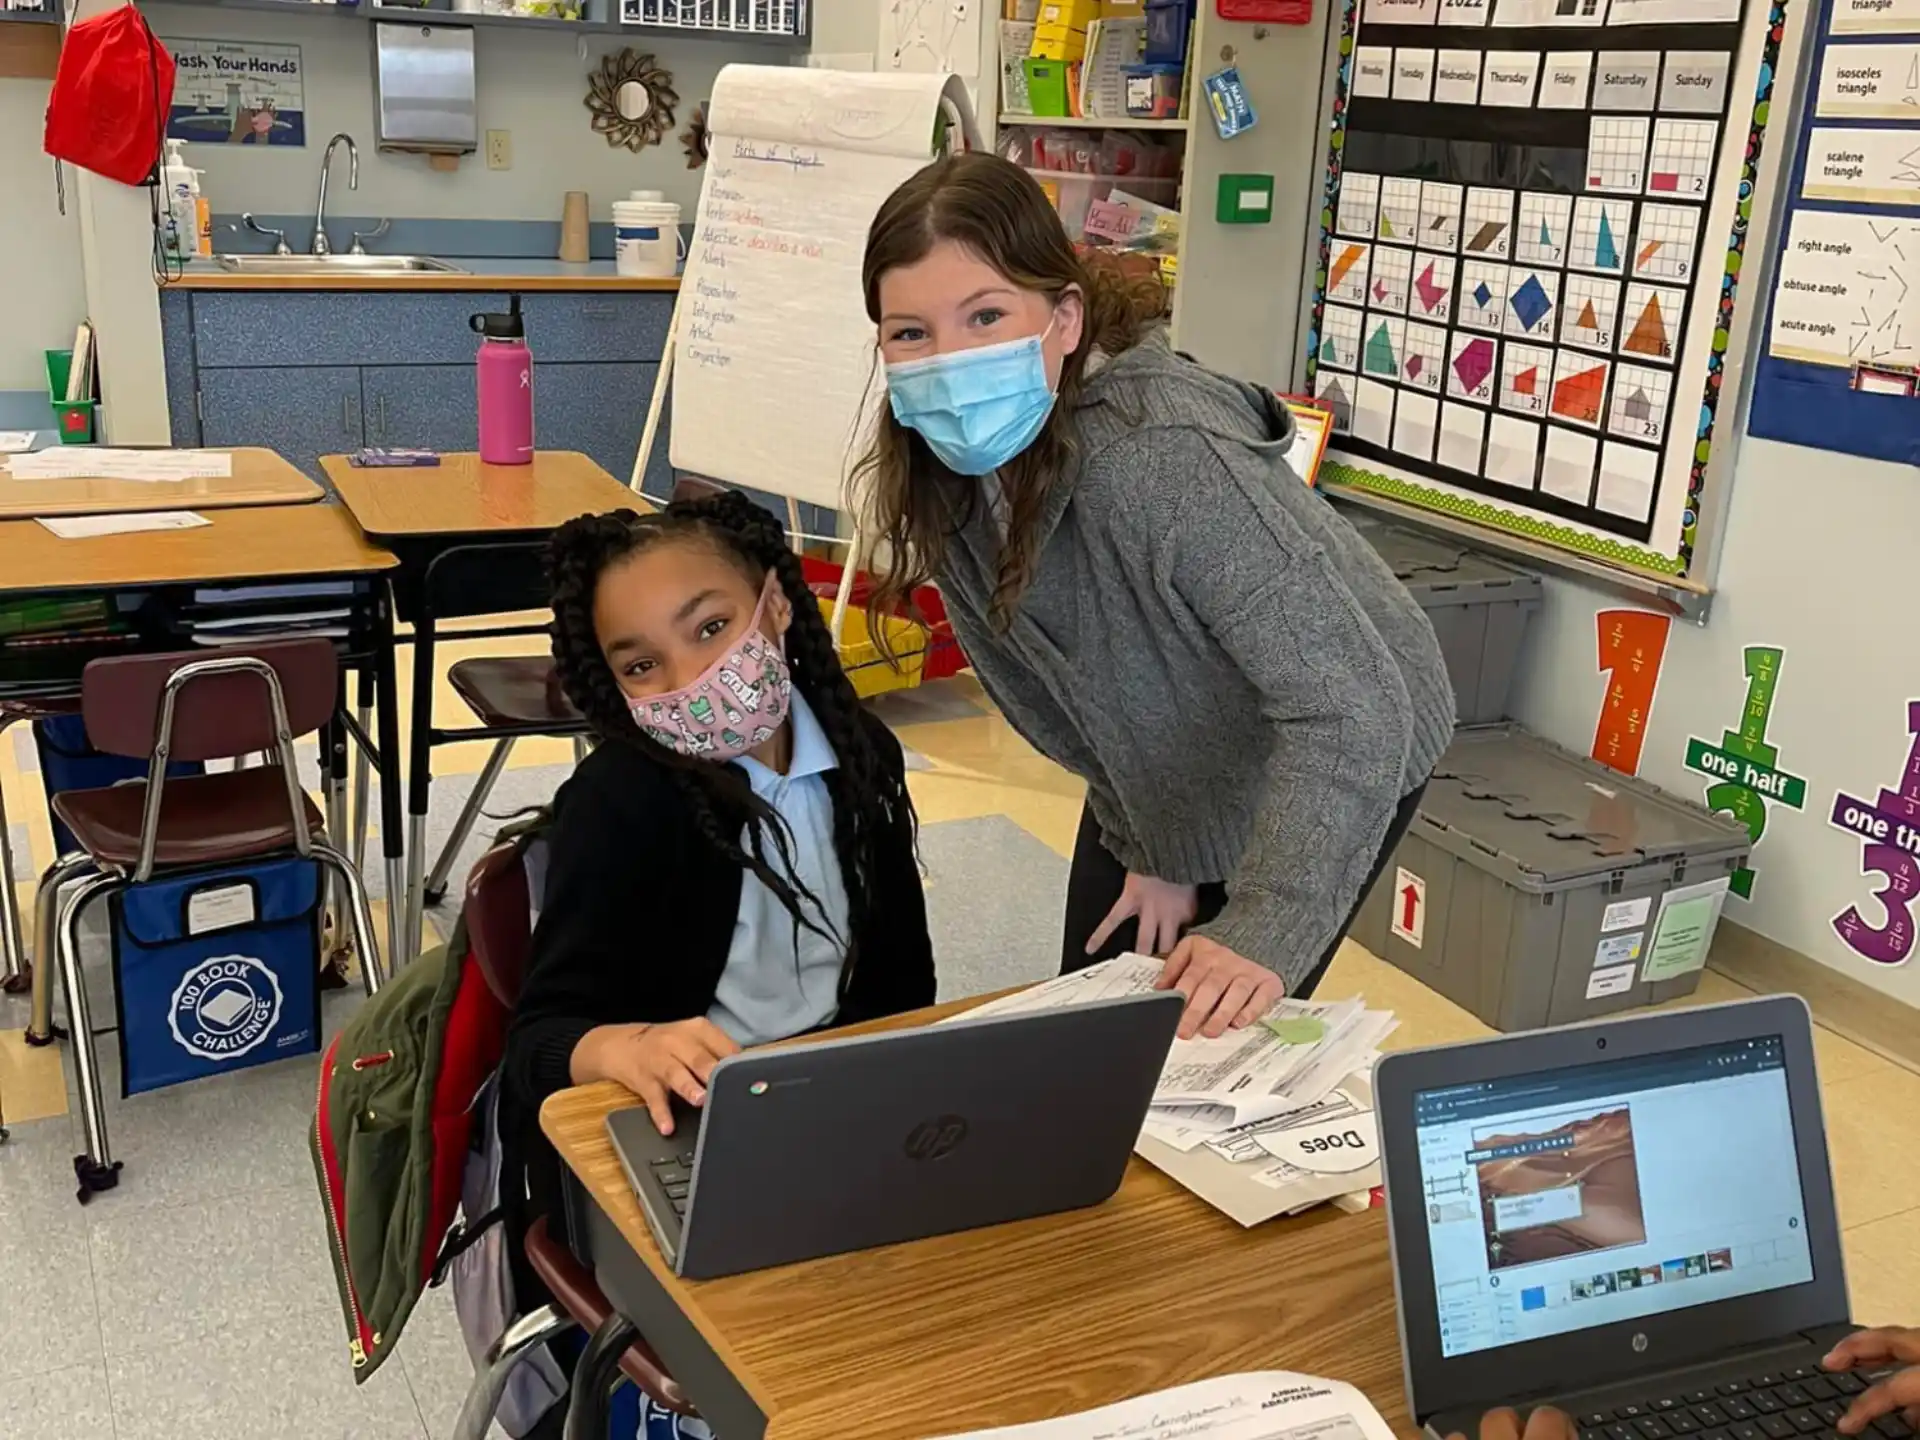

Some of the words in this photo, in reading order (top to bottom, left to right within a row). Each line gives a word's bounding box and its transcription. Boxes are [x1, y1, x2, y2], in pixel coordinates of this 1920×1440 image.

[1851, 0, 1893, 12] triangle
[174, 52, 209, 69] ash
[212, 55, 247, 72] Your
[249, 57, 297, 74] Hands
[1400, 67, 1425, 80] Tuesday
[1490, 71, 1529, 86] Thursday
[1554, 73, 1576, 86] Friday
[1837, 67, 1882, 79] isosceles
[1603, 73, 1648, 88] Saturday
[1675, 73, 1714, 90] Sunday
[1837, 83, 1877, 96] triangle
[1827, 151, 1864, 163] scalene
[1824, 166, 1863, 179] triangle
[1694, 178, 1703, 191] 2
[1553, 248, 1561, 260] 7
[1798, 240, 1822, 254] right
[1823, 243, 1852, 256] angle
[1678, 263, 1687, 276] 9
[1783, 278, 1816, 292] obtuse
[1818, 283, 1848, 296] angle
[1436, 305, 1446, 317] 12
[1538, 321, 1549, 334] 14
[1780, 320, 1806, 331] acute
[1808, 323, 1836, 335] angle
[1595, 332, 1608, 345] 15
[1427, 374, 1438, 386] 19
[1476, 385, 1489, 398] 20
[1531, 398, 1542, 410] 21
[1643, 422, 1658, 436] 23
[1701, 751, 1739, 779] one
[1743, 764, 1789, 798] half
[1844, 807, 1889, 838] one
[179, 984, 201, 1011] 100
[197, 962, 251, 986] BOOK
[192, 998, 272, 1052] CHALLENGE
[1299, 1130, 1366, 1154] Does
